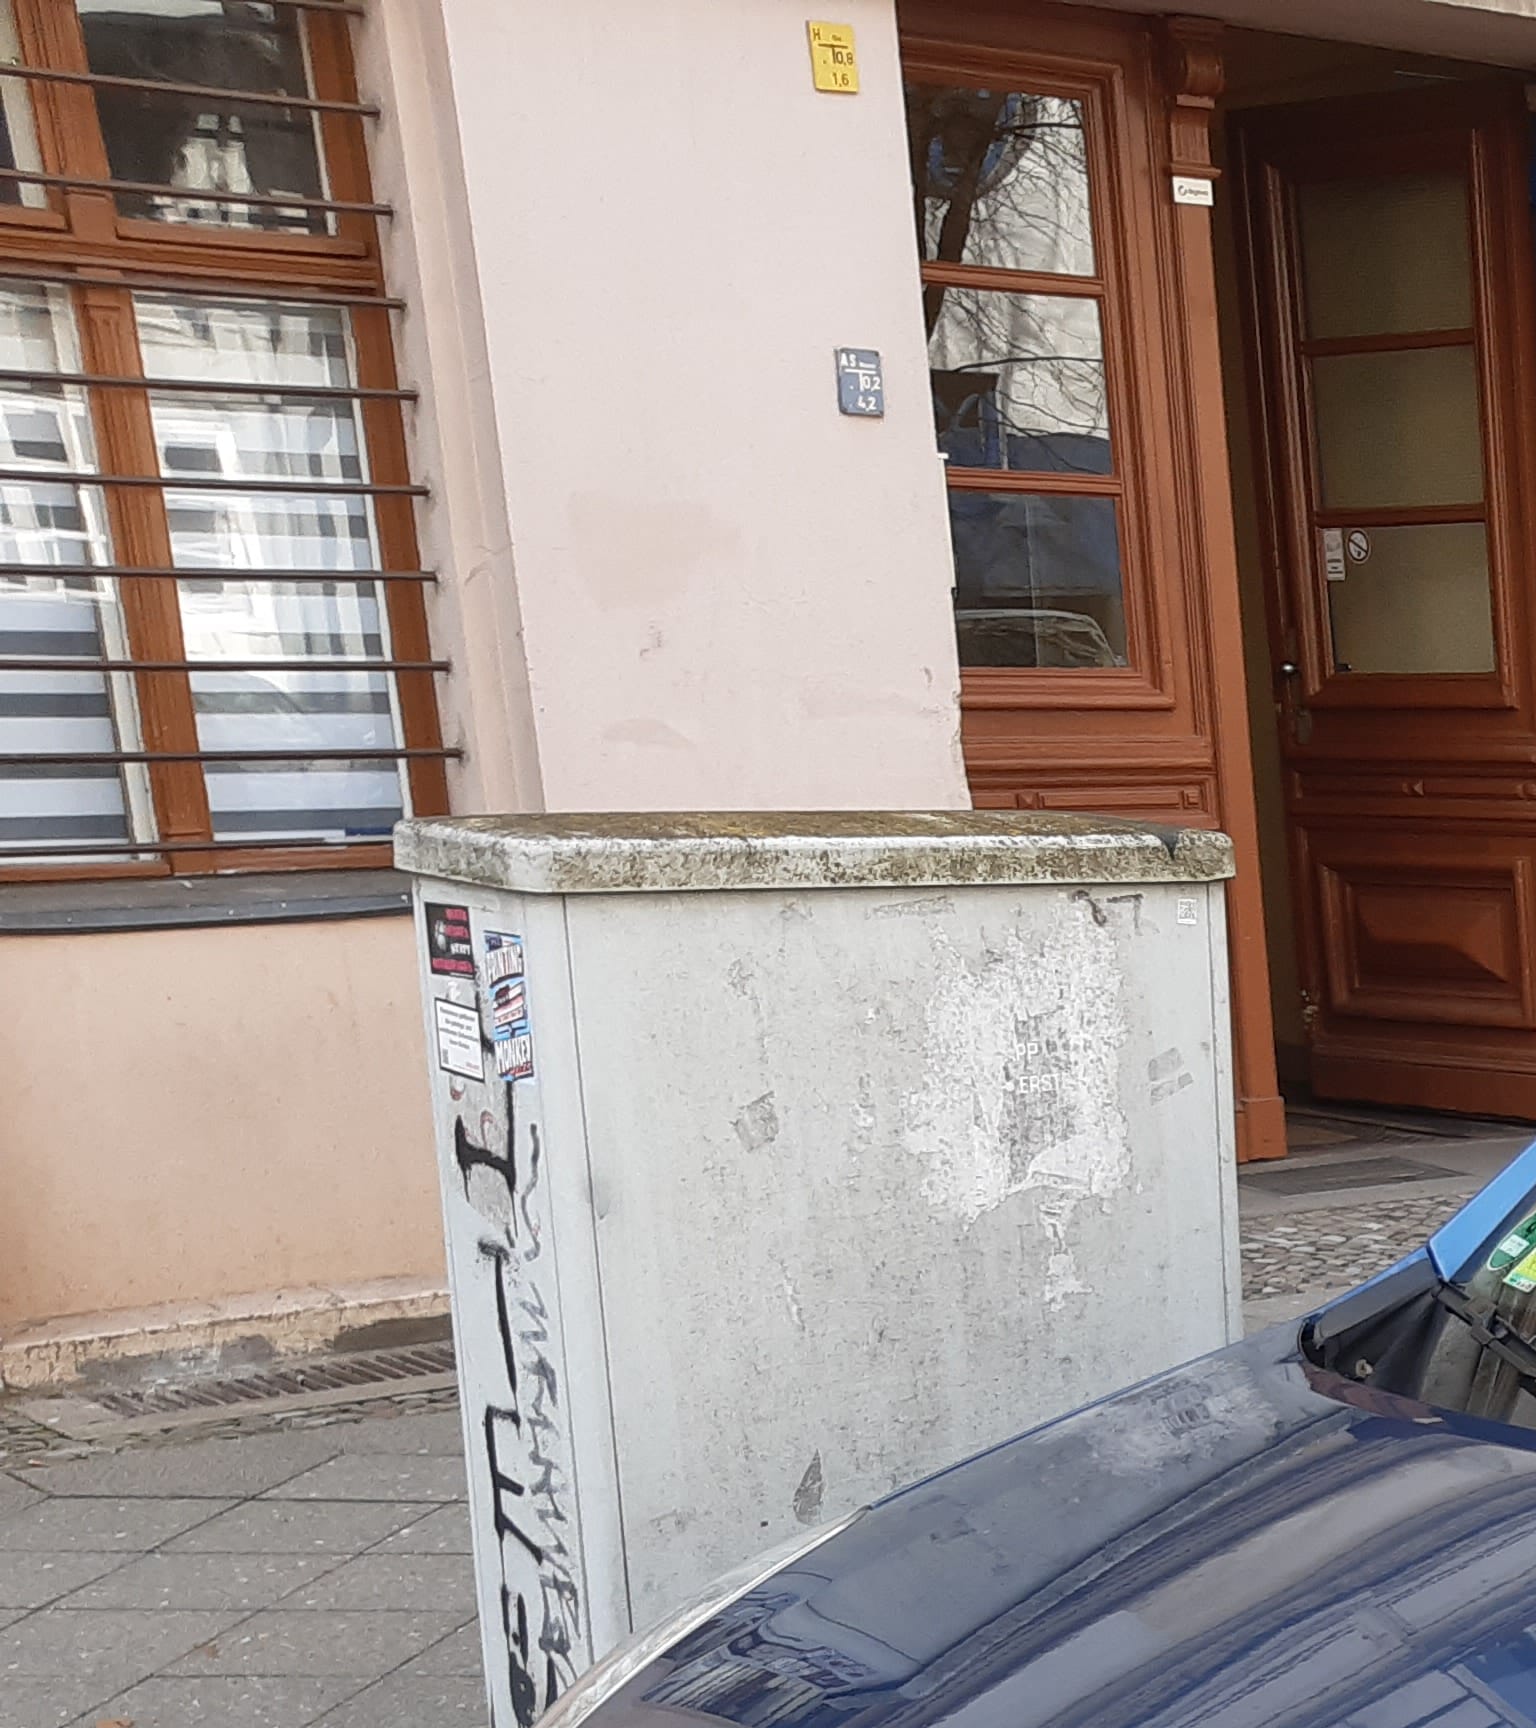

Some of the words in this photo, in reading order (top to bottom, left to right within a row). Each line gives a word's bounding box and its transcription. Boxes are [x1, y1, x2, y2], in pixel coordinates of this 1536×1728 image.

[812, 28, 821, 41] H
[836, 51, 853, 66] 0,8
[833, 72, 849, 87] 1,6
